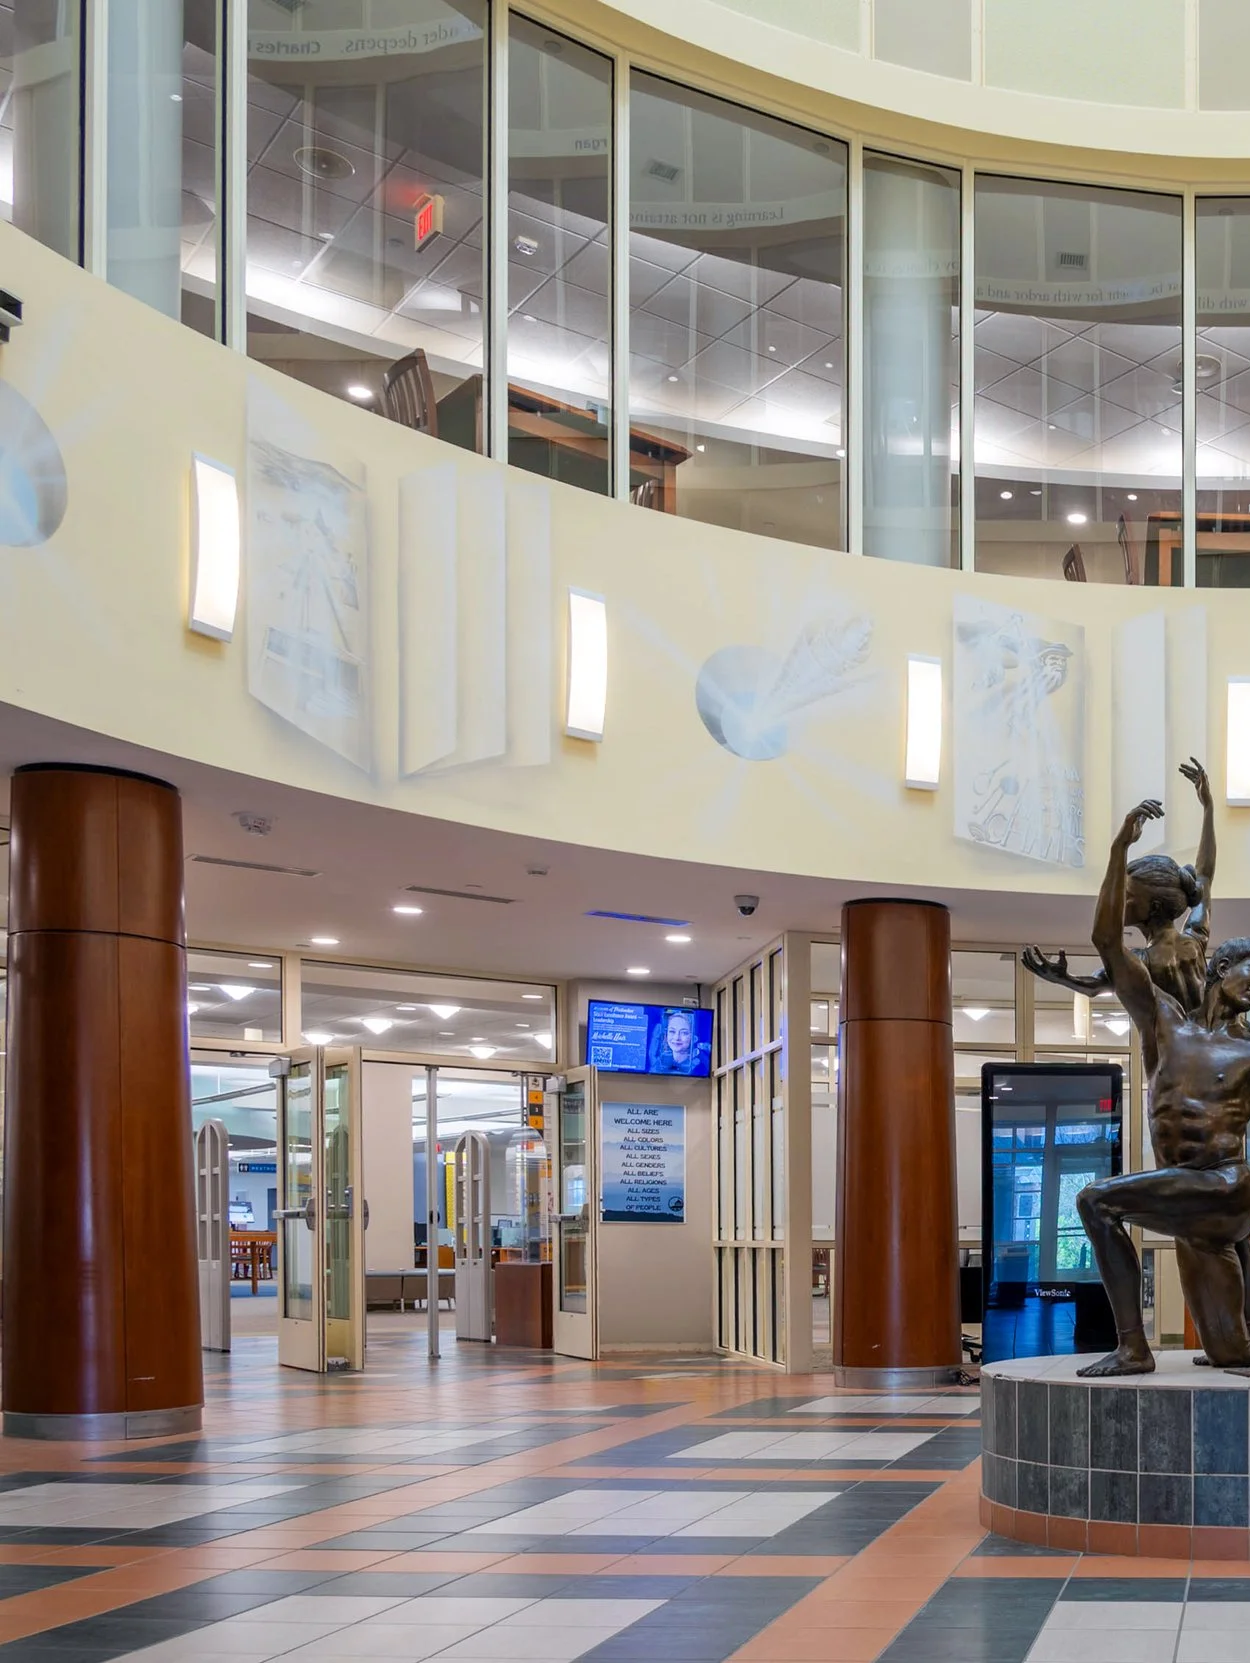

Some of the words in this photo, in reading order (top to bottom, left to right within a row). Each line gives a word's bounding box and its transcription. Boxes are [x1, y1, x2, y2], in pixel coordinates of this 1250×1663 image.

[417, 203, 433, 241] EXIT
[614, 1118, 651, 1126] WELCOME
[652, 1119, 673, 1127] HERE
[1033, 1288, 1072, 1297] ViewSonic
